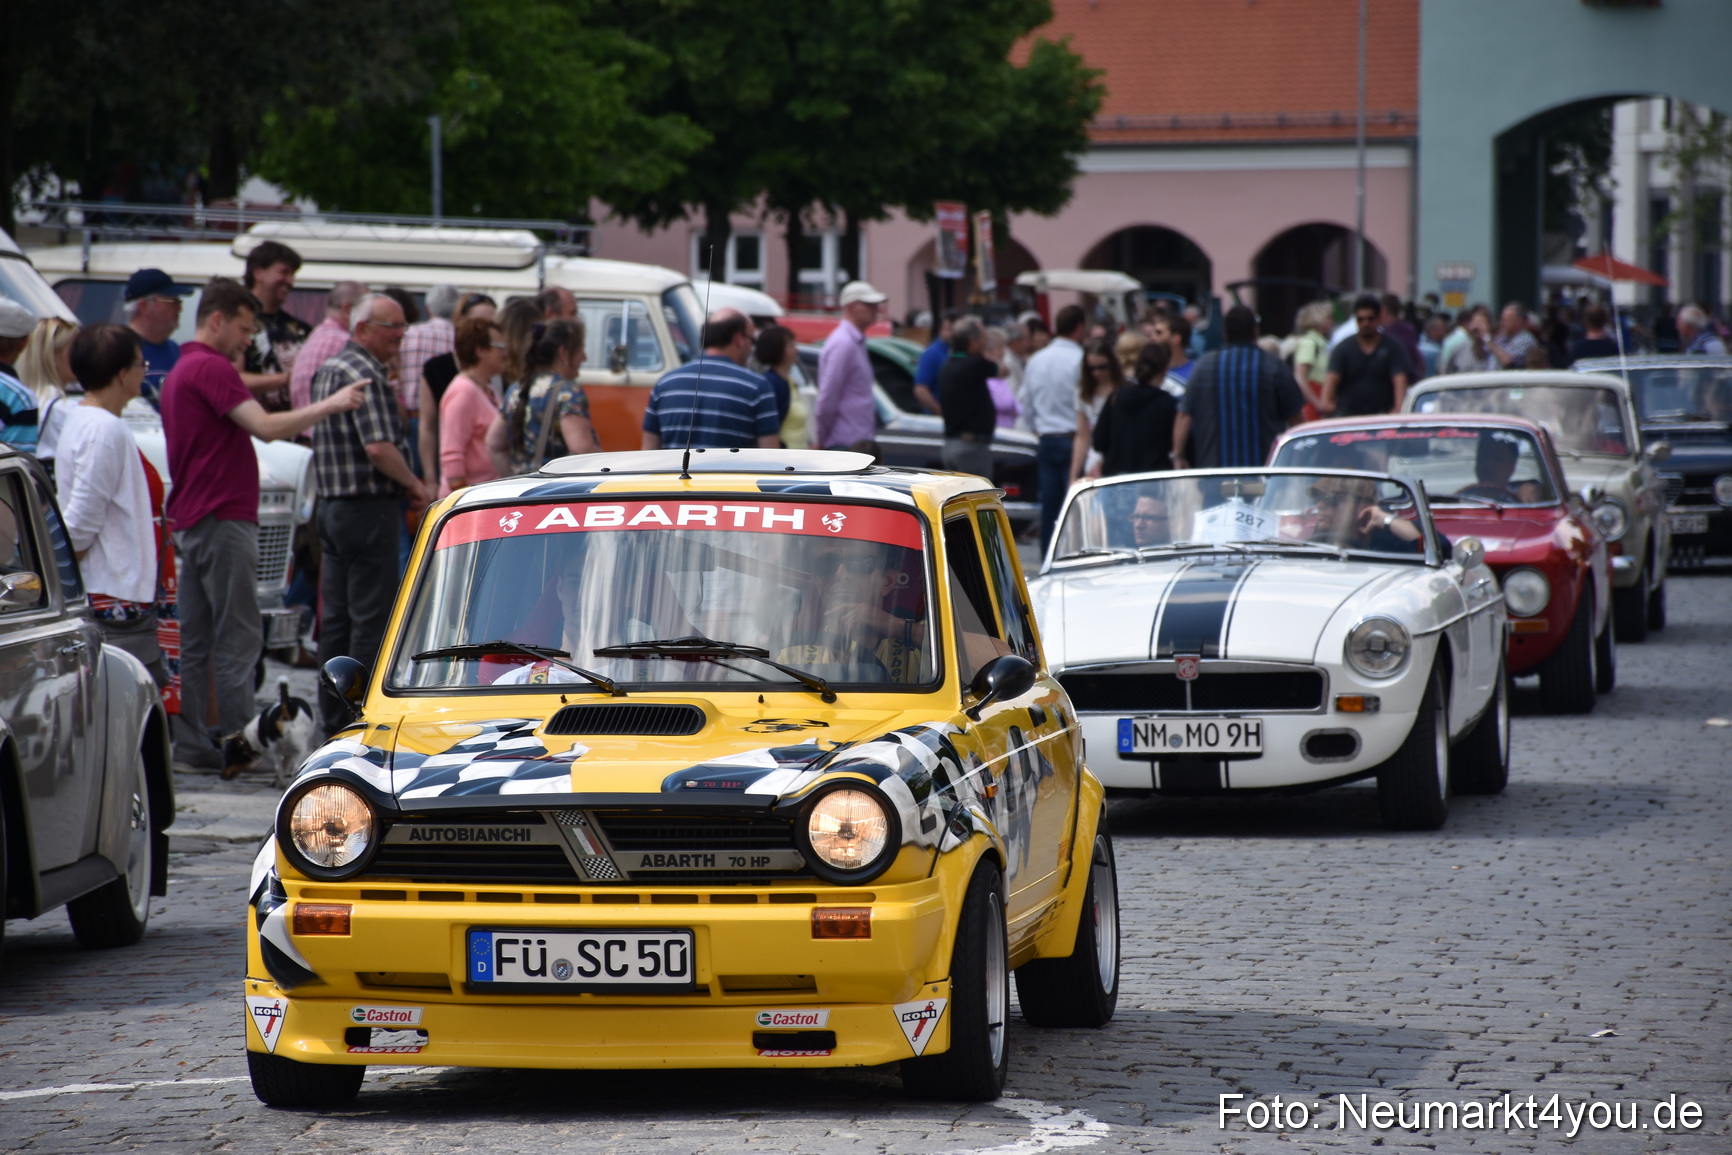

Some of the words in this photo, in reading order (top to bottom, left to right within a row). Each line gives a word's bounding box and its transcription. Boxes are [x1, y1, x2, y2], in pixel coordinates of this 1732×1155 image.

[534, 504, 805, 530] ABARTH
[1235, 511, 1265, 529] 287
[1122, 739, 1130, 747] D
[1133, 723, 1167, 748] NM
[1186, 723, 1220, 748] MO
[1227, 723, 1261, 748] 9H
[408, 827, 531, 843] AUTOBIANCHI
[640, 854, 716, 868] ABARTH
[728, 856, 747, 868] 70
[750, 856, 771, 868] HP
[477, 961, 487, 973] D
[495, 938, 547, 977] FÜ
[577, 939, 629, 978] SC
[637, 939, 688, 978] 50
[255, 1008, 281, 1017] KONI
[366, 1009, 412, 1022] Castrol
[773, 1013, 819, 1026] Castrol
[902, 1010, 936, 1022] KONI
